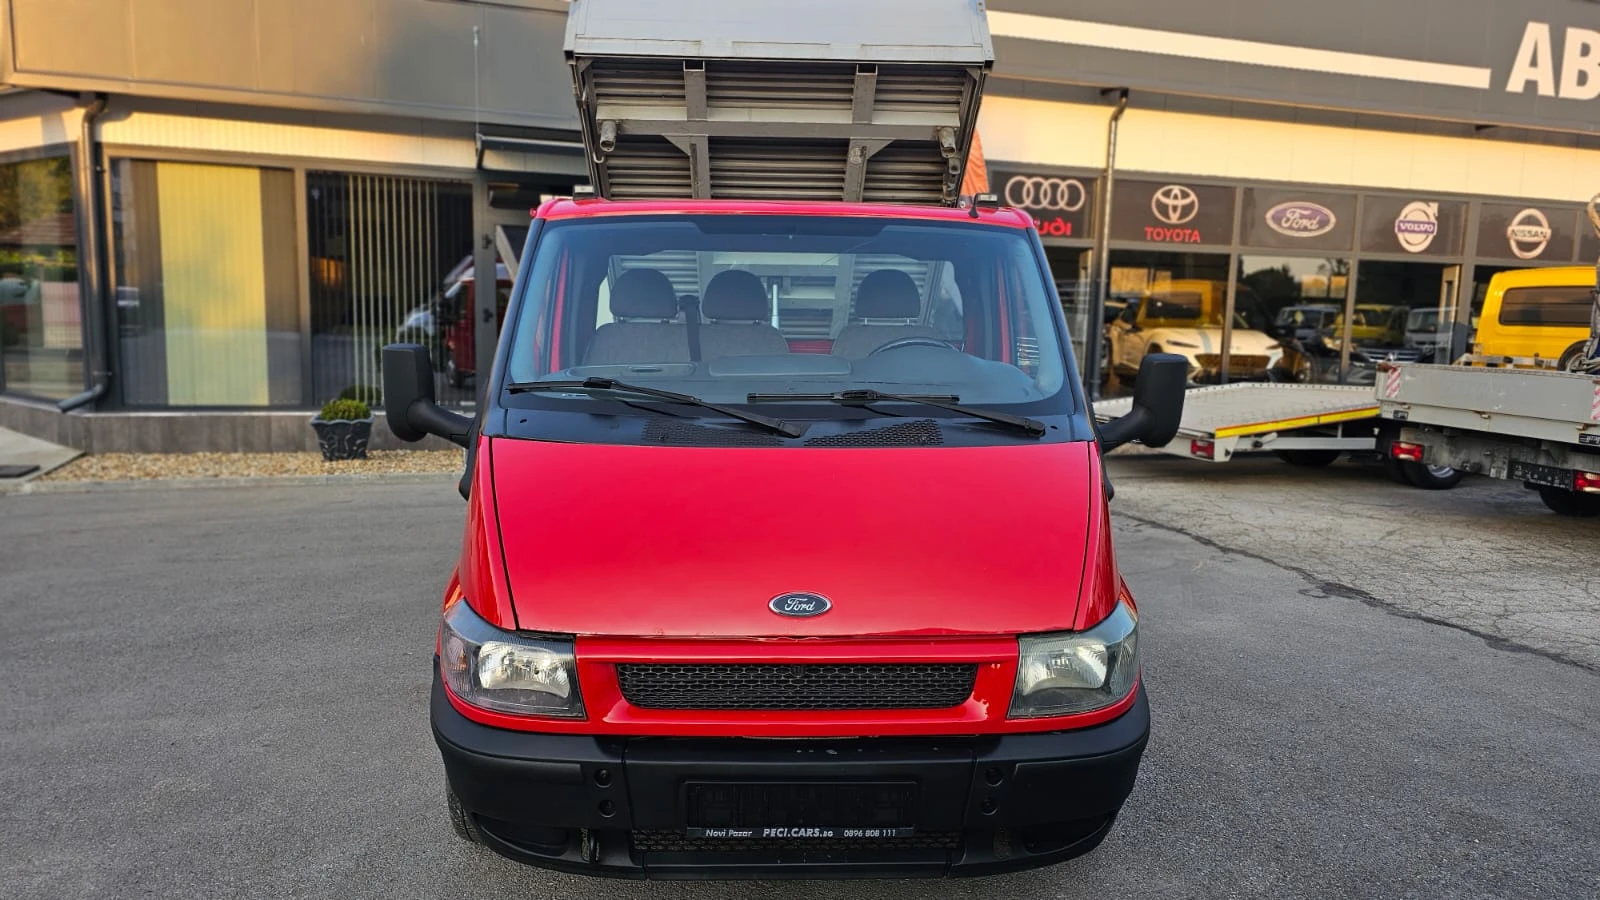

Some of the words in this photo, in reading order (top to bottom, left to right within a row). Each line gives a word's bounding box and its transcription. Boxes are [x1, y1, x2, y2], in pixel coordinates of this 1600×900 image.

[1505, 21, 1600, 100] AB
[1033, 215, 1072, 237] udi
[1281, 208, 1320, 231] Ford
[1400, 222, 1434, 232] VOLVO
[1144, 227, 1201, 243] TOYOTA
[1511, 228, 1548, 239] NISSAN
[784, 597, 816, 611] Ford
[705, 828, 727, 838] Novi
[728, 829, 753, 838] Pazar
[843, 829, 864, 838] 0896
[865, 829, 880, 838] 808
[882, 829, 897, 838] 111
